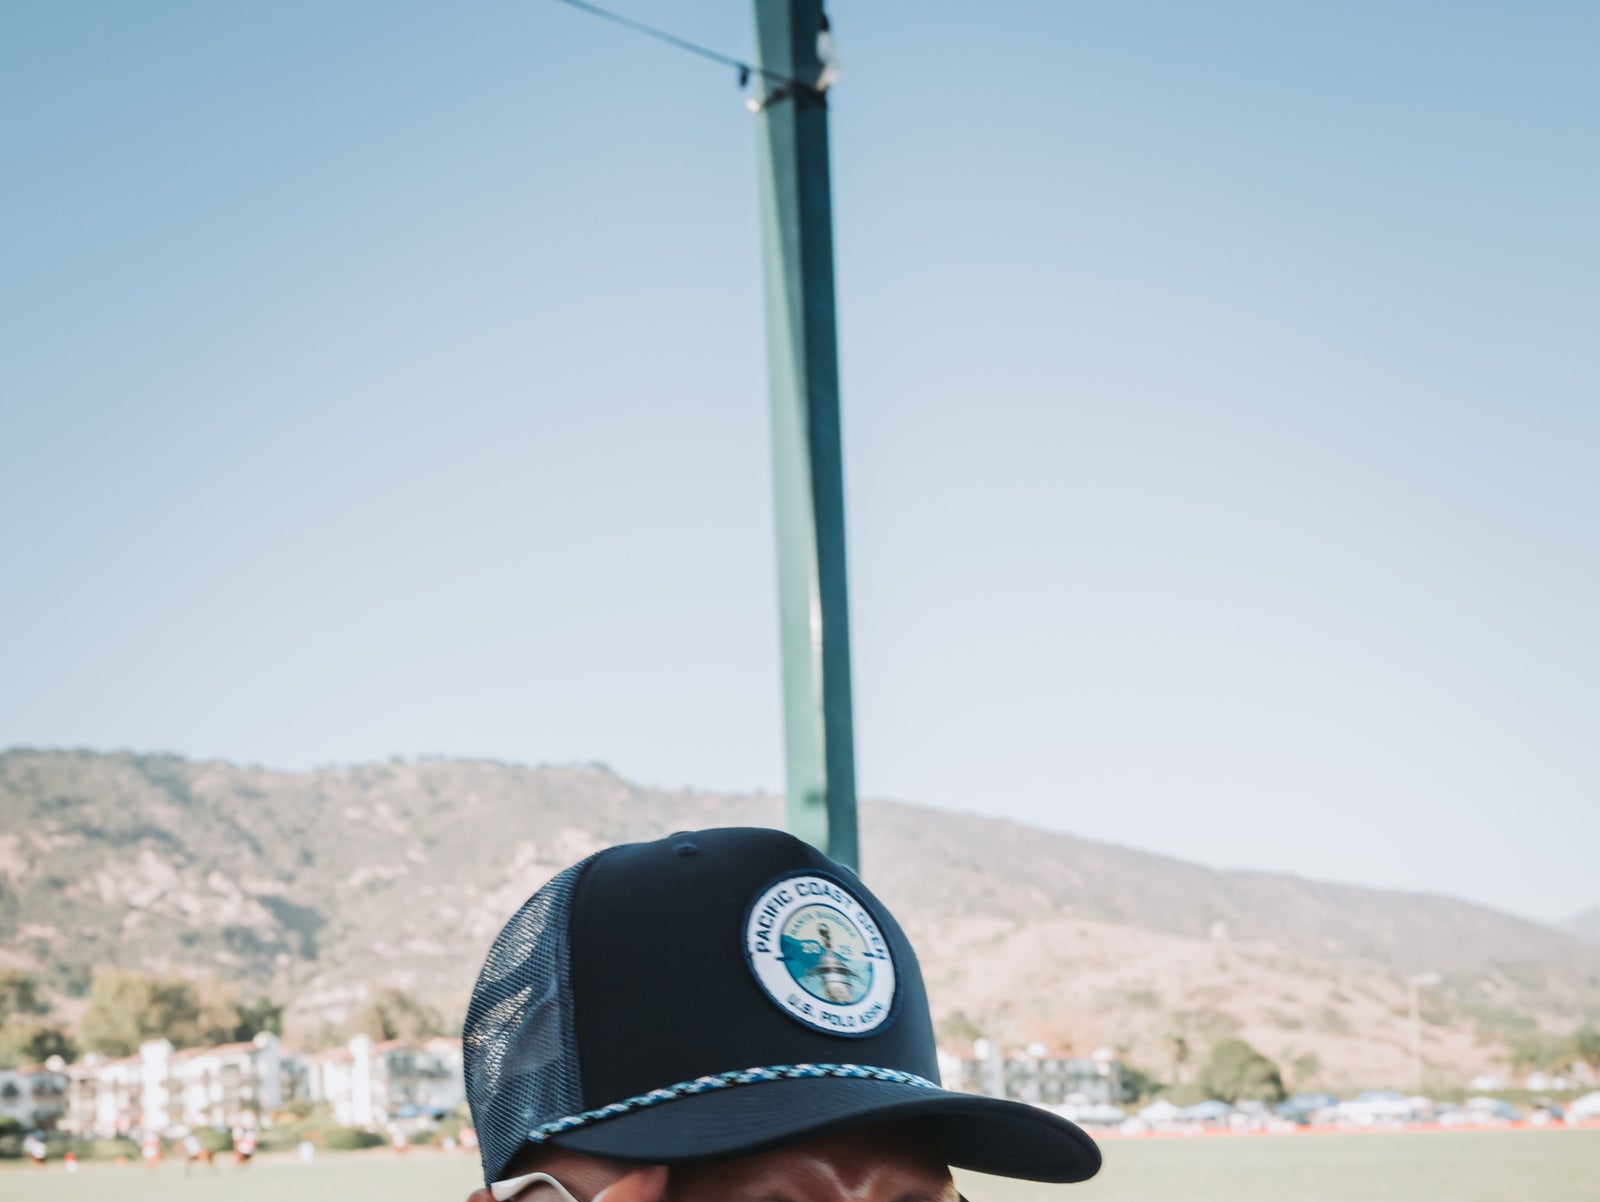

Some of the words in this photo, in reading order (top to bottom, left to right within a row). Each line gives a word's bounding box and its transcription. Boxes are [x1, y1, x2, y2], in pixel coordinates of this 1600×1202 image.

[755, 890, 793, 953] PACIFIC
[795, 882, 853, 909] COAST
[821, 1011, 856, 1027] POLO
